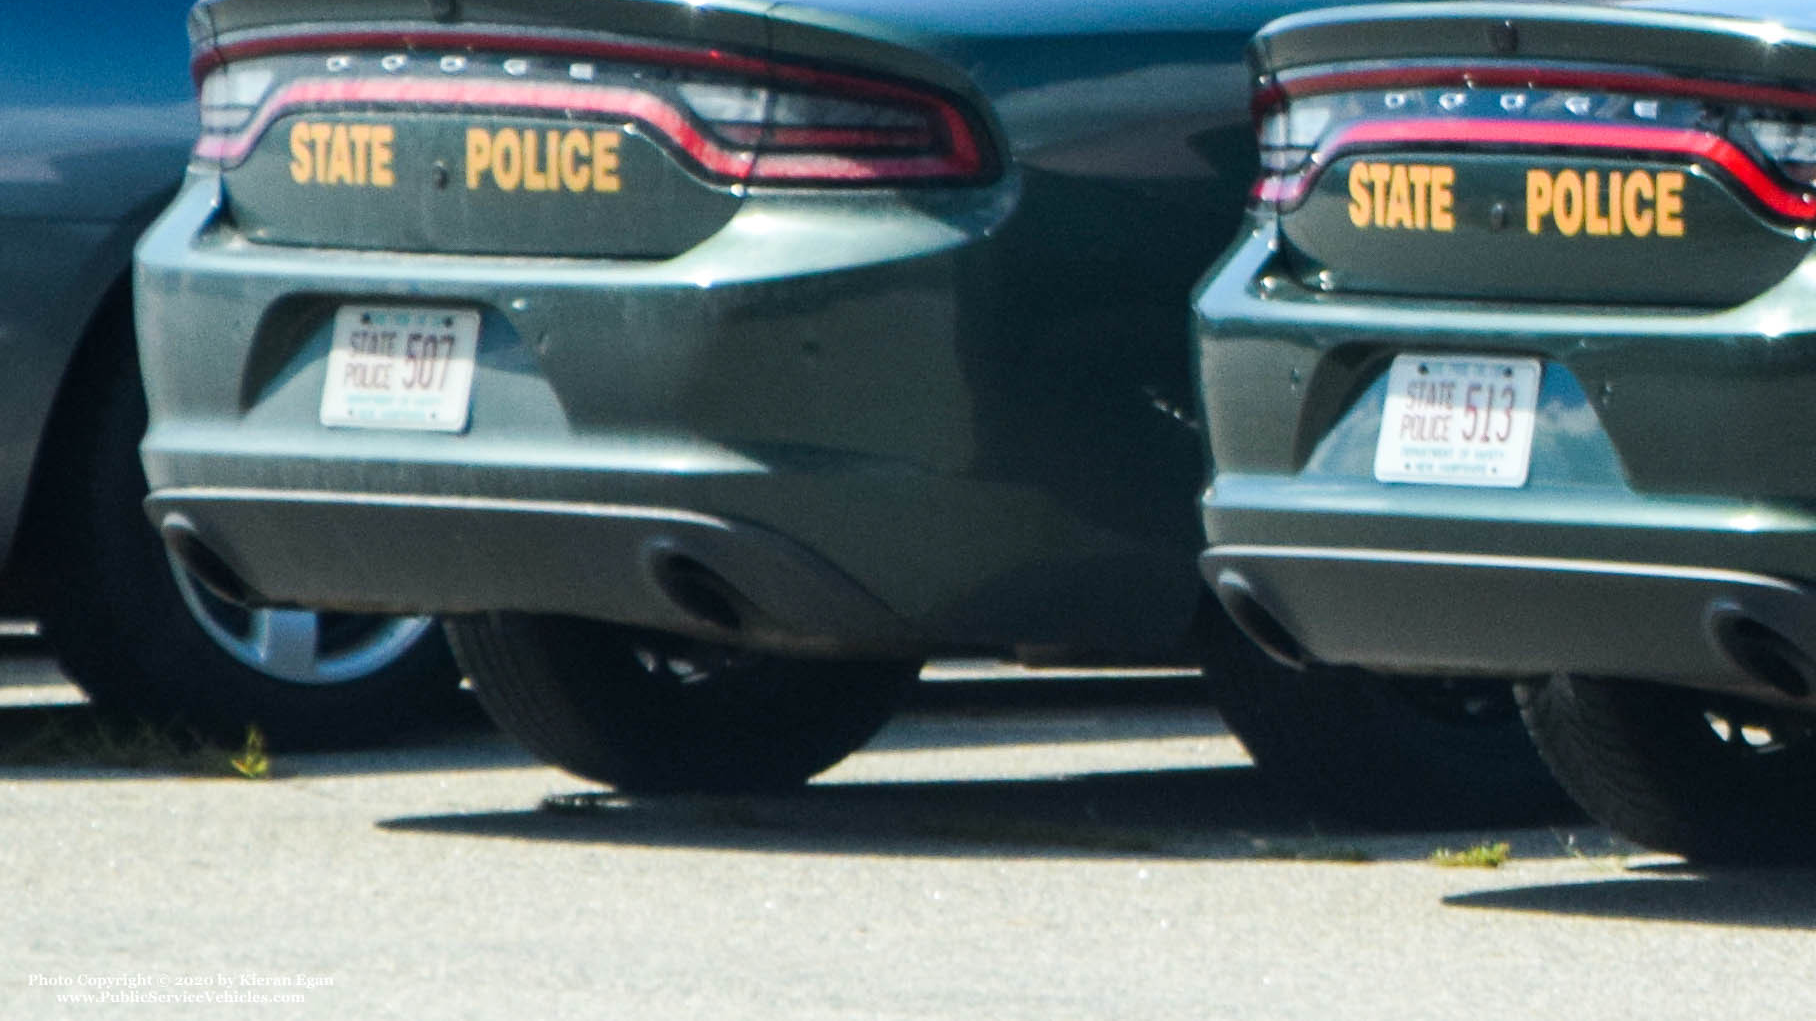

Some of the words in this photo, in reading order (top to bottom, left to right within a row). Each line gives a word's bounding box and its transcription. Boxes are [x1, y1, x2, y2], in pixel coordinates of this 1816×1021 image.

[288, 122, 396, 187] STATE
[465, 127, 622, 193] POLICE
[1347, 161, 1455, 232] STATE
[1526, 169, 1686, 237] POLICE
[351, 331, 397, 356] STATE
[402, 333, 455, 391] 507
[344, 363, 392, 390] POLICE
[1405, 381, 1455, 409] STATE
[1400, 414, 1452, 442] POLICE
[1462, 383, 1515, 442] 513
